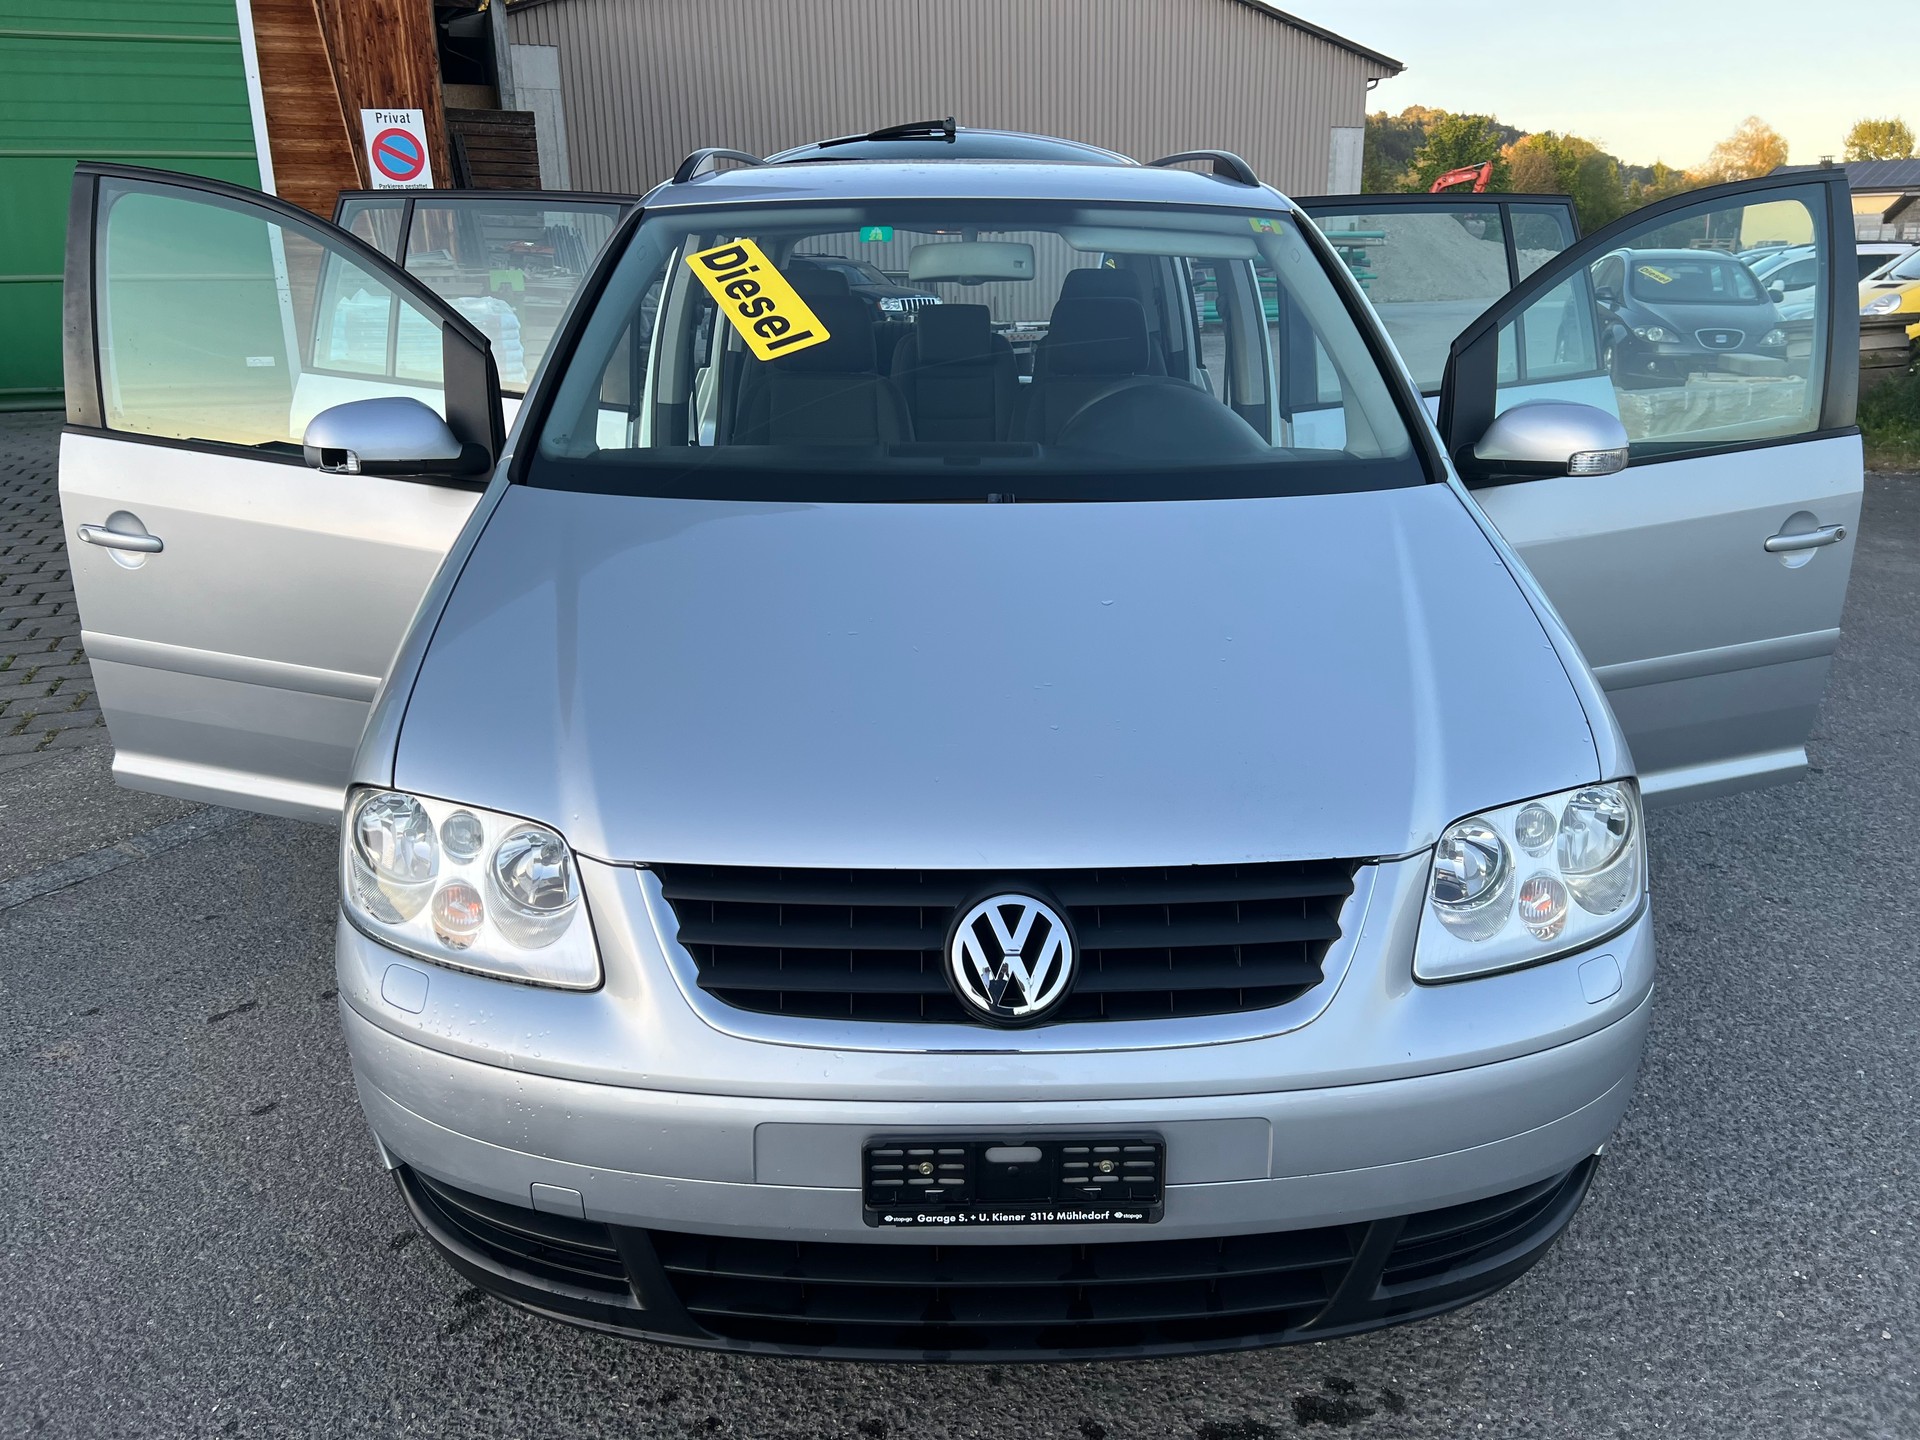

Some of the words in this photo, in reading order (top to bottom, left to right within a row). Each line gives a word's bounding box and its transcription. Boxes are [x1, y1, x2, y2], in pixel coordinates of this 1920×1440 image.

[375, 112, 411, 124] Privat
[700, 245, 814, 351] Diesel
[952, 894, 1072, 1017] VW
[917, 1213, 956, 1224] Garage
[958, 1213, 968, 1222] S.
[978, 1212, 990, 1222] U.
[992, 1212, 1026, 1222] Kiener
[1030, 1212, 1054, 1221] 3116
[1056, 1210, 1110, 1220] Mühledorf
